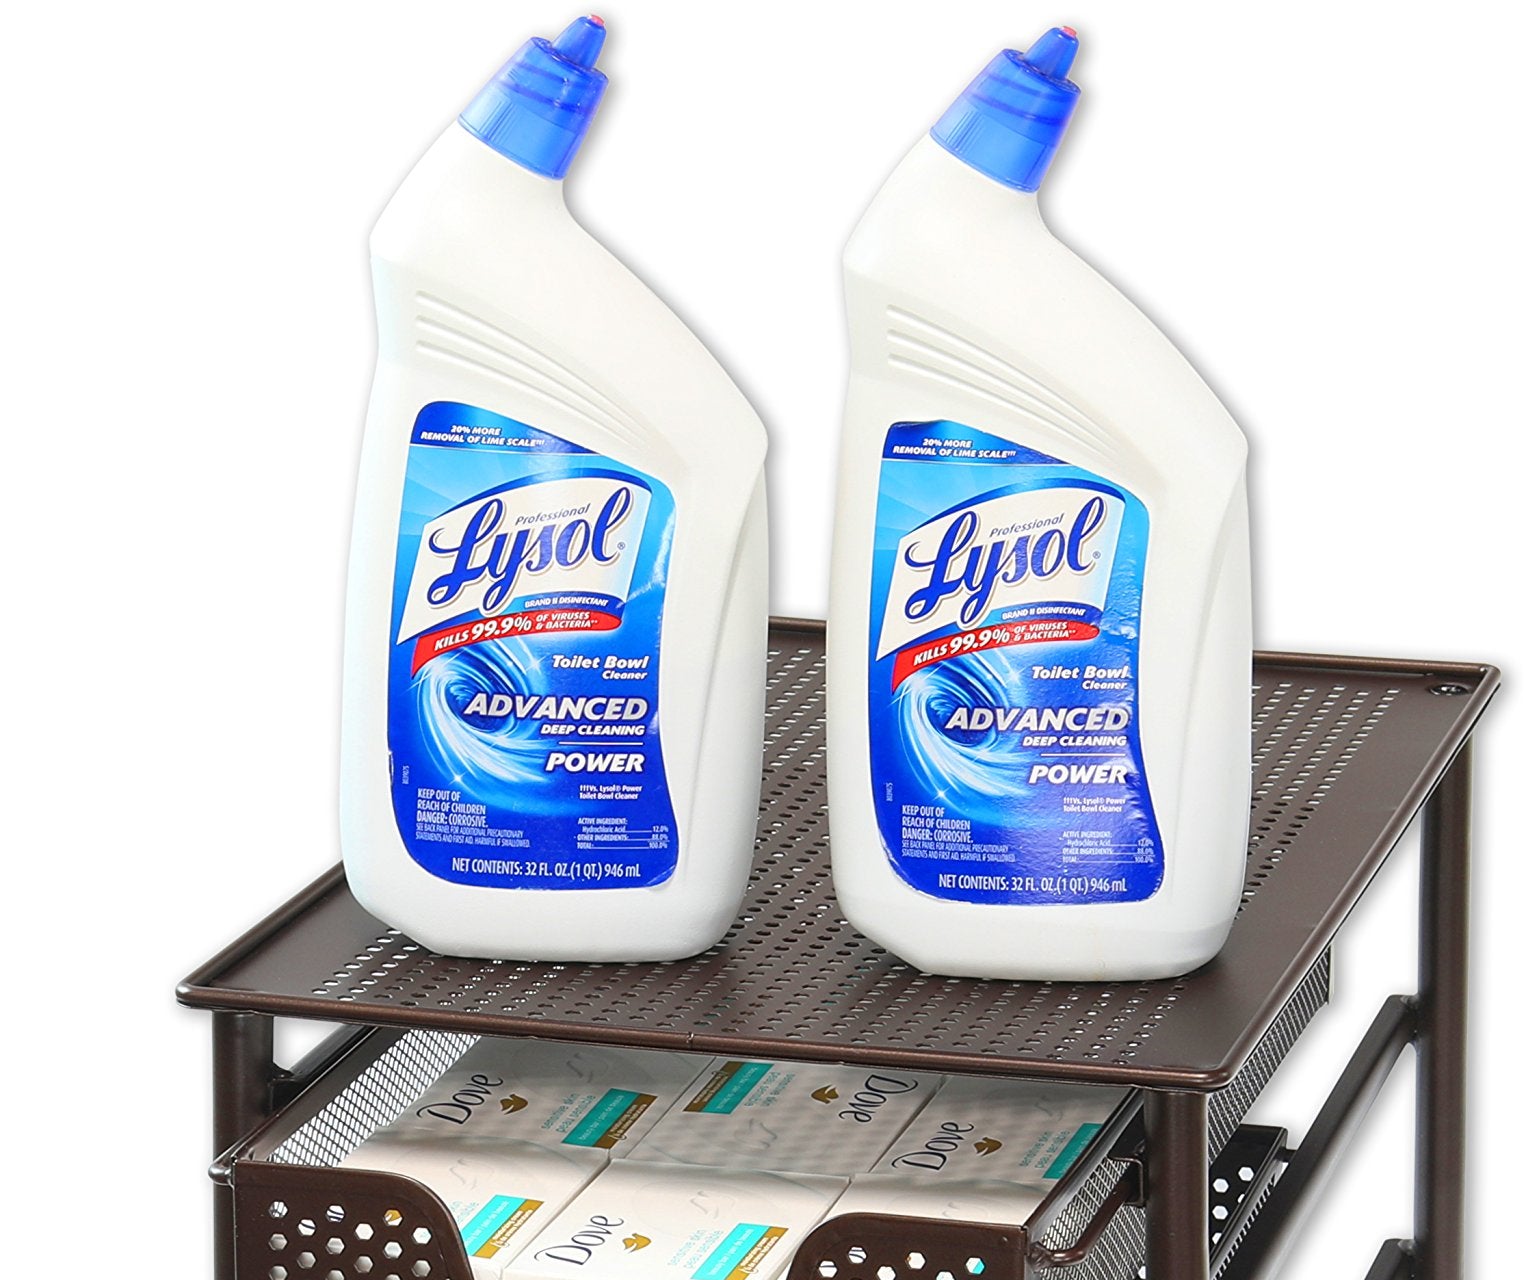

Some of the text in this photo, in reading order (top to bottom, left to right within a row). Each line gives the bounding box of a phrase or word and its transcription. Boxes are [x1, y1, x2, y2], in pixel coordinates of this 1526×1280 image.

[421, 431, 464, 443] REMOVAL
[467, 436, 480, 444] OF
[481, 437, 504, 445] LIME
[451, 425, 501, 436] 20% MORE
[923, 438, 972, 448] 20% MORE
[893, 445, 937, 456] REMOVAL
[938, 448, 952, 457] OF
[953, 449, 976, 458] LIME
[515, 503, 590, 526] Professional
[989, 513, 1065, 538] Professional
[525, 599, 550, 608] BRAND
[559, 597, 608, 607] DISINFECTANT
[1002, 609, 1029, 620] BRAND
[1036, 606, 1086, 617] DISINFECTANT
[434, 612, 590, 650] KILLS 99.9% OF VIRUSES
[535, 622, 543, 630] &
[913, 622, 1068, 666] KILLS 99.9% OF VIRUSES
[1014, 633, 1021, 641] &
[552, 655, 649, 670] Toilet Bowl
[602, 670, 647, 680] Cleaner
[1031, 666, 1128, 680] Toilet Bowl
[1082, 680, 1127, 690] Cleaner
[464, 692, 648, 720] ADVANCED
[944, 707, 1129, 731] ADVANCED
[540, 724, 645, 736] DEEP CLEANING
[1022, 735, 1127, 747] DEEP CLEANING
[545, 753, 644, 773] POWER
[1028, 764, 1128, 784] POWER
[418, 788, 461, 802] KEEP OUT OF
[580, 792, 596, 800] Toilet
[417, 799, 486, 815] REACH OF CHILDREN
[902, 805, 945, 817] KEEP OUT OF
[417, 810, 489, 828] DANGER: CORROSIVE.
[902, 816, 971, 830] REACH OF CHILDREN
[902, 827, 973, 843] DANGER: CORROSIVE.
[452, 857, 471, 873] NET
[472, 859, 523, 875] CONTENTS:
[524, 862, 537, 876] 32
[539, 863, 552, 876] FL.
[605, 863, 623, 877] 946
[625, 863, 641, 877] mL
[939, 874, 956, 888] NET
[958, 875, 1009, 891] CONTENTS:
[1011, 877, 1023, 891] 32
[1025, 878, 1039, 891] FL.
[1090, 878, 1110, 892] 946
[1112, 878, 1127, 892] mL
[416, 1074, 504, 1124] Dove
[838, 1074, 918, 1123] Dove
[891, 1122, 975, 1170] Dove
[534, 1215, 625, 1265] Dove
